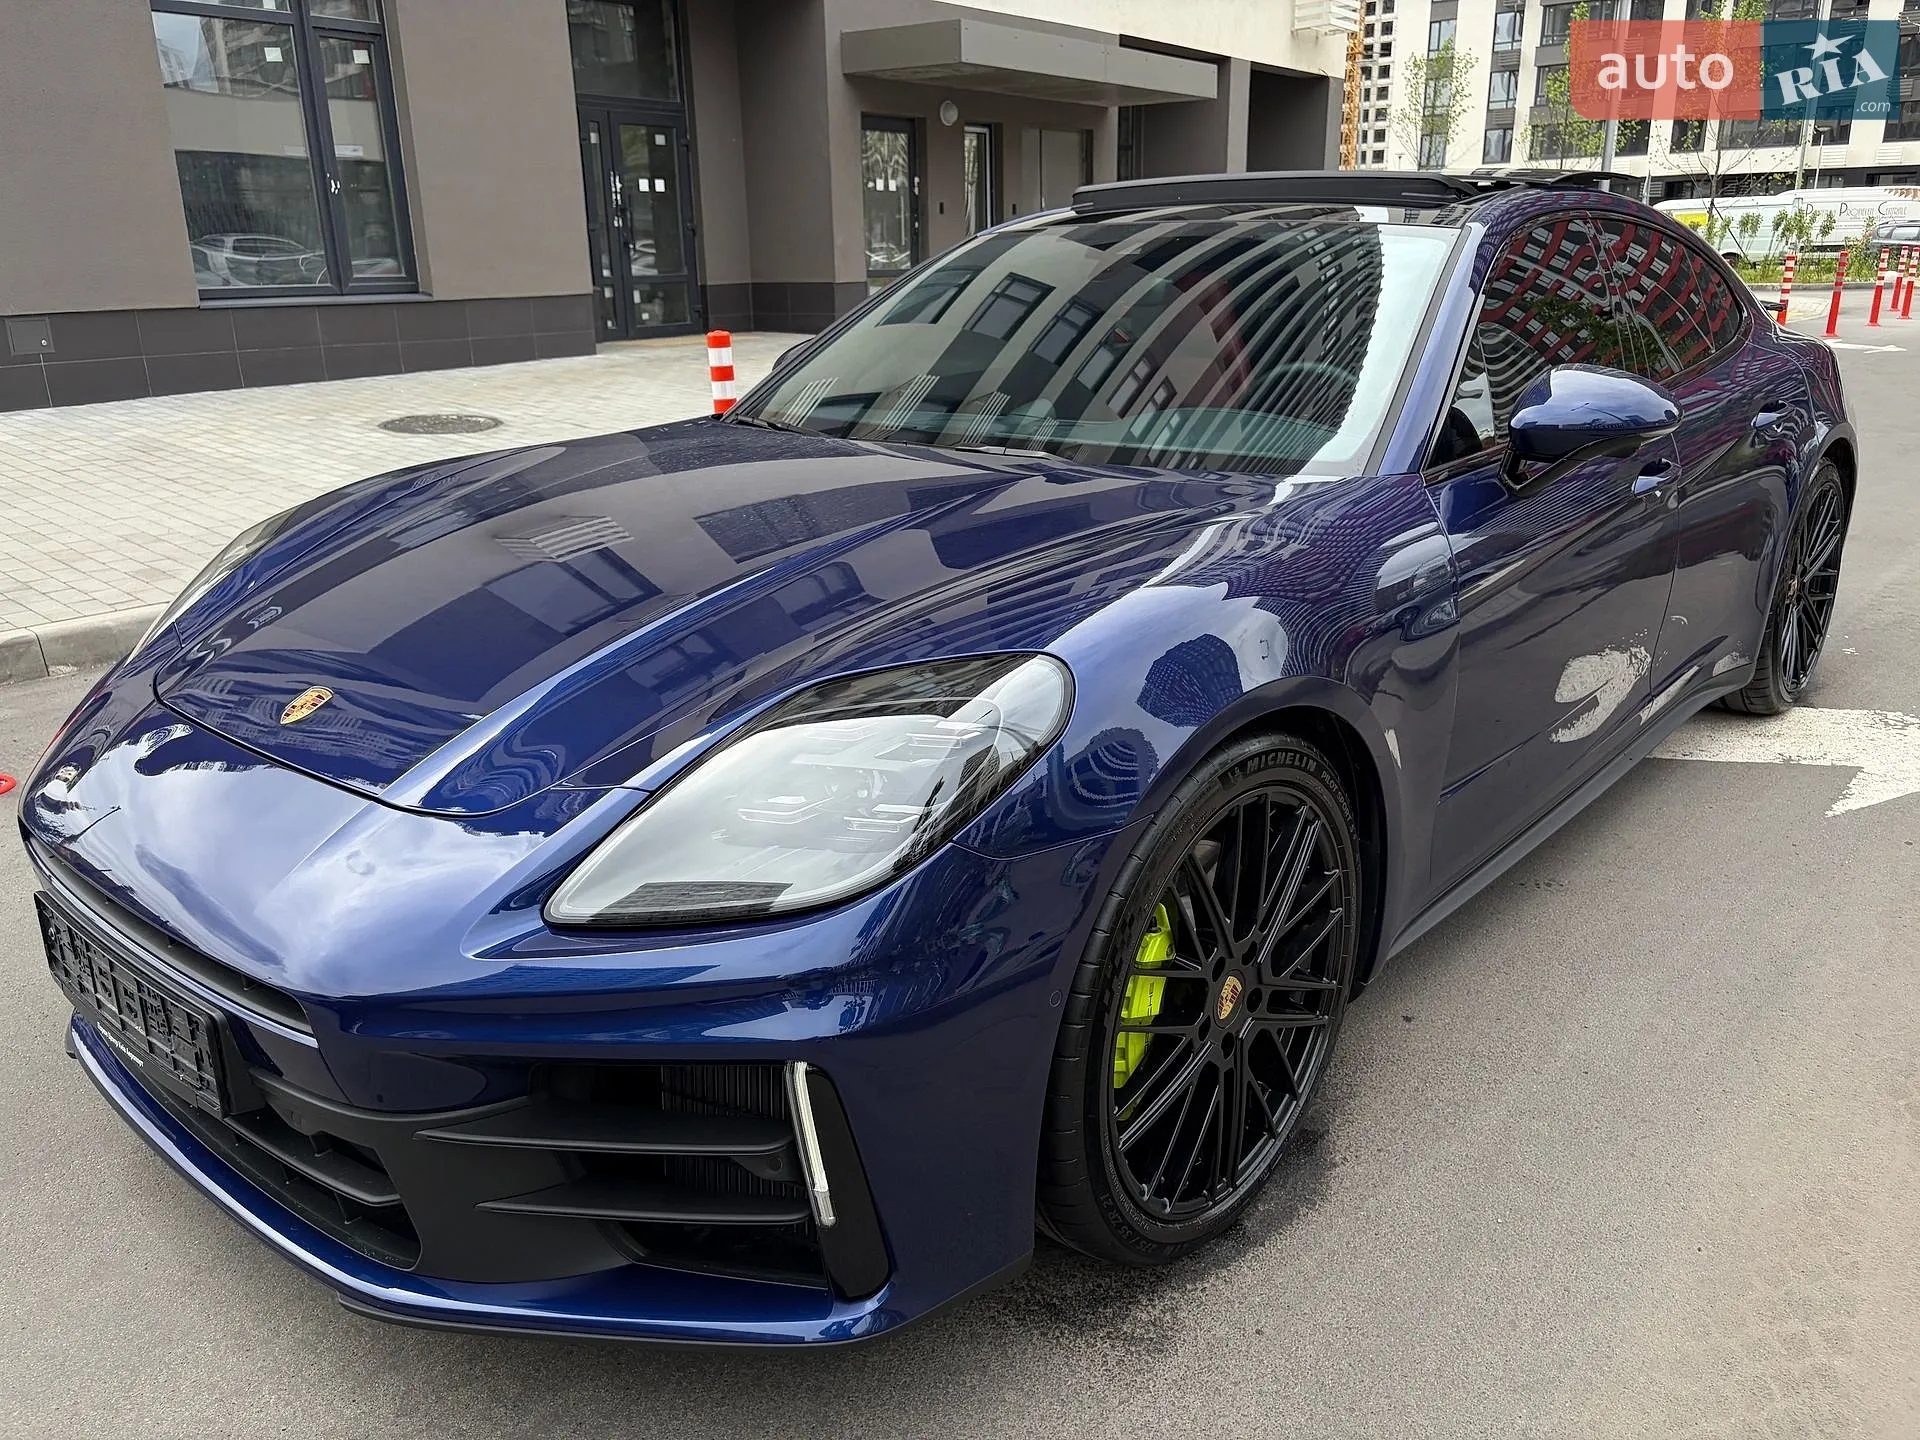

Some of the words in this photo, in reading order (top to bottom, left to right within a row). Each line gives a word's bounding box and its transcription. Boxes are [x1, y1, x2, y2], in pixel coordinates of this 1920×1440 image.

[1246, 751, 1318, 774] MICHELIN
[1321, 770, 1338, 793] PILOT
[1337, 791, 1353, 822] SPORT
